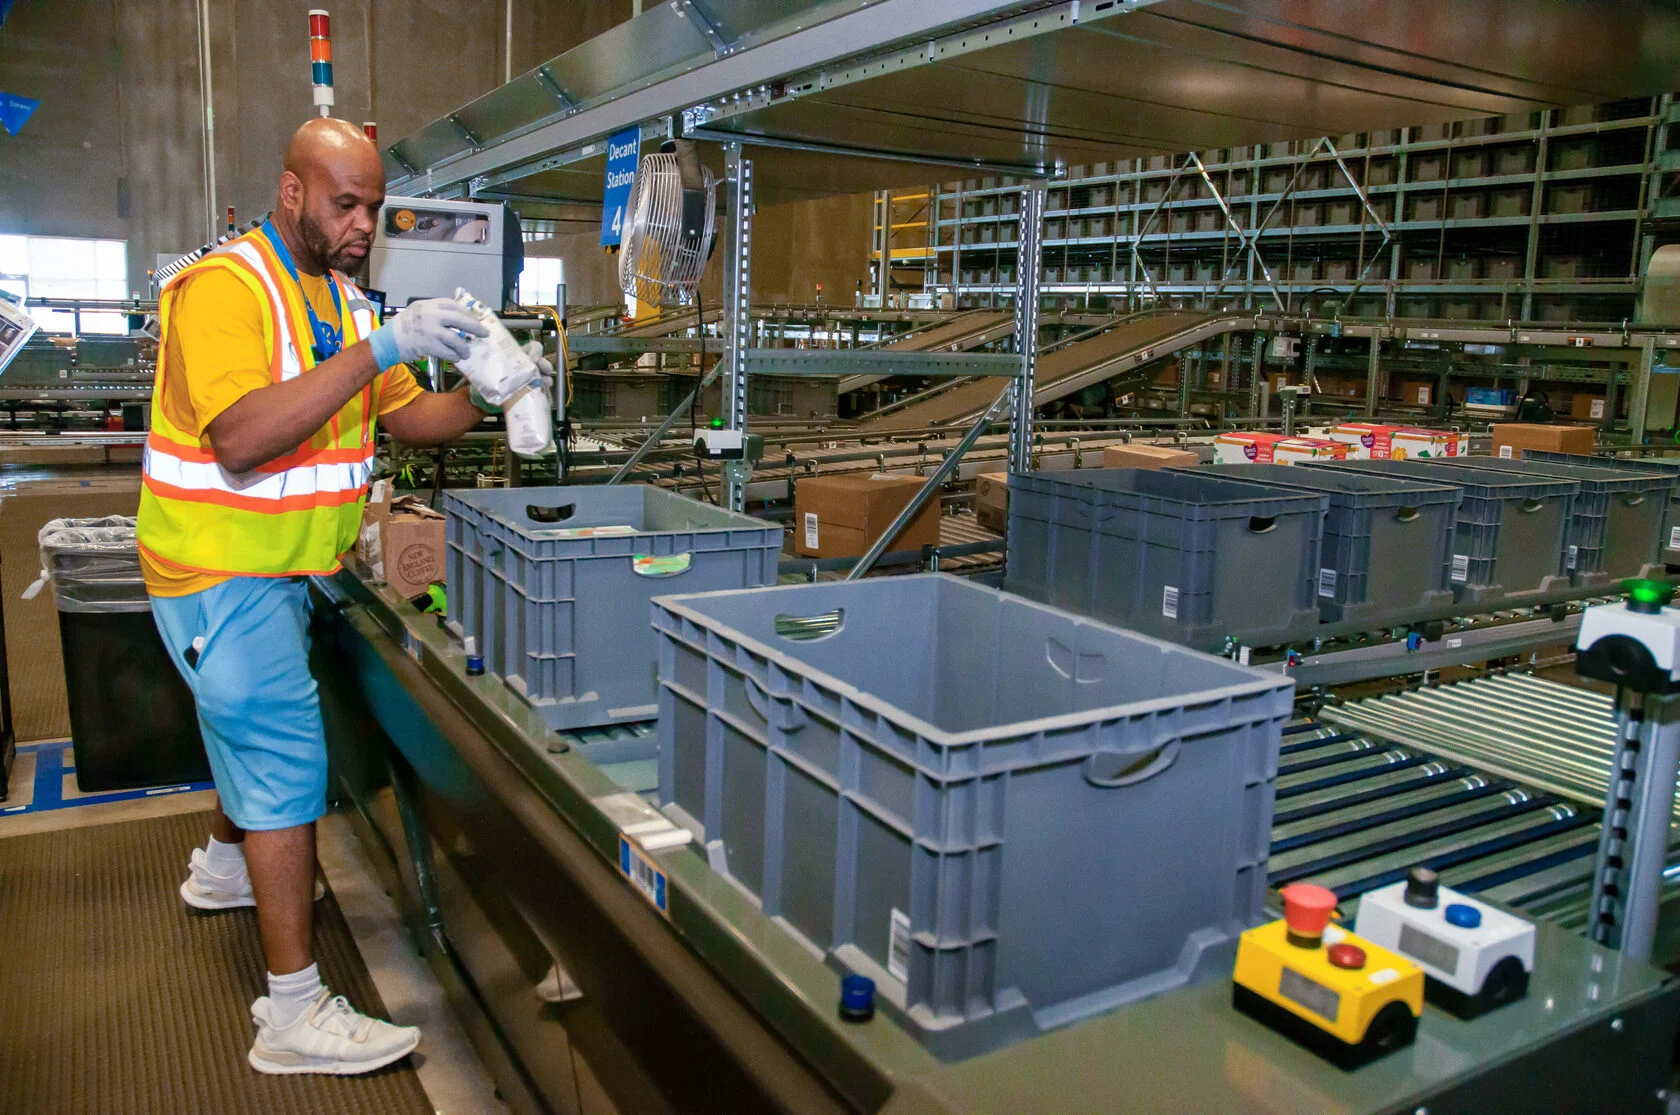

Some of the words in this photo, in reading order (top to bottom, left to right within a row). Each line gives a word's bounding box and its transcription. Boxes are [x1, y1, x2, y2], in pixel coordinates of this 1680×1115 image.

[609, 139, 637, 161] Decant
[607, 168, 635, 189] Station
[611, 206, 621, 236] 4
